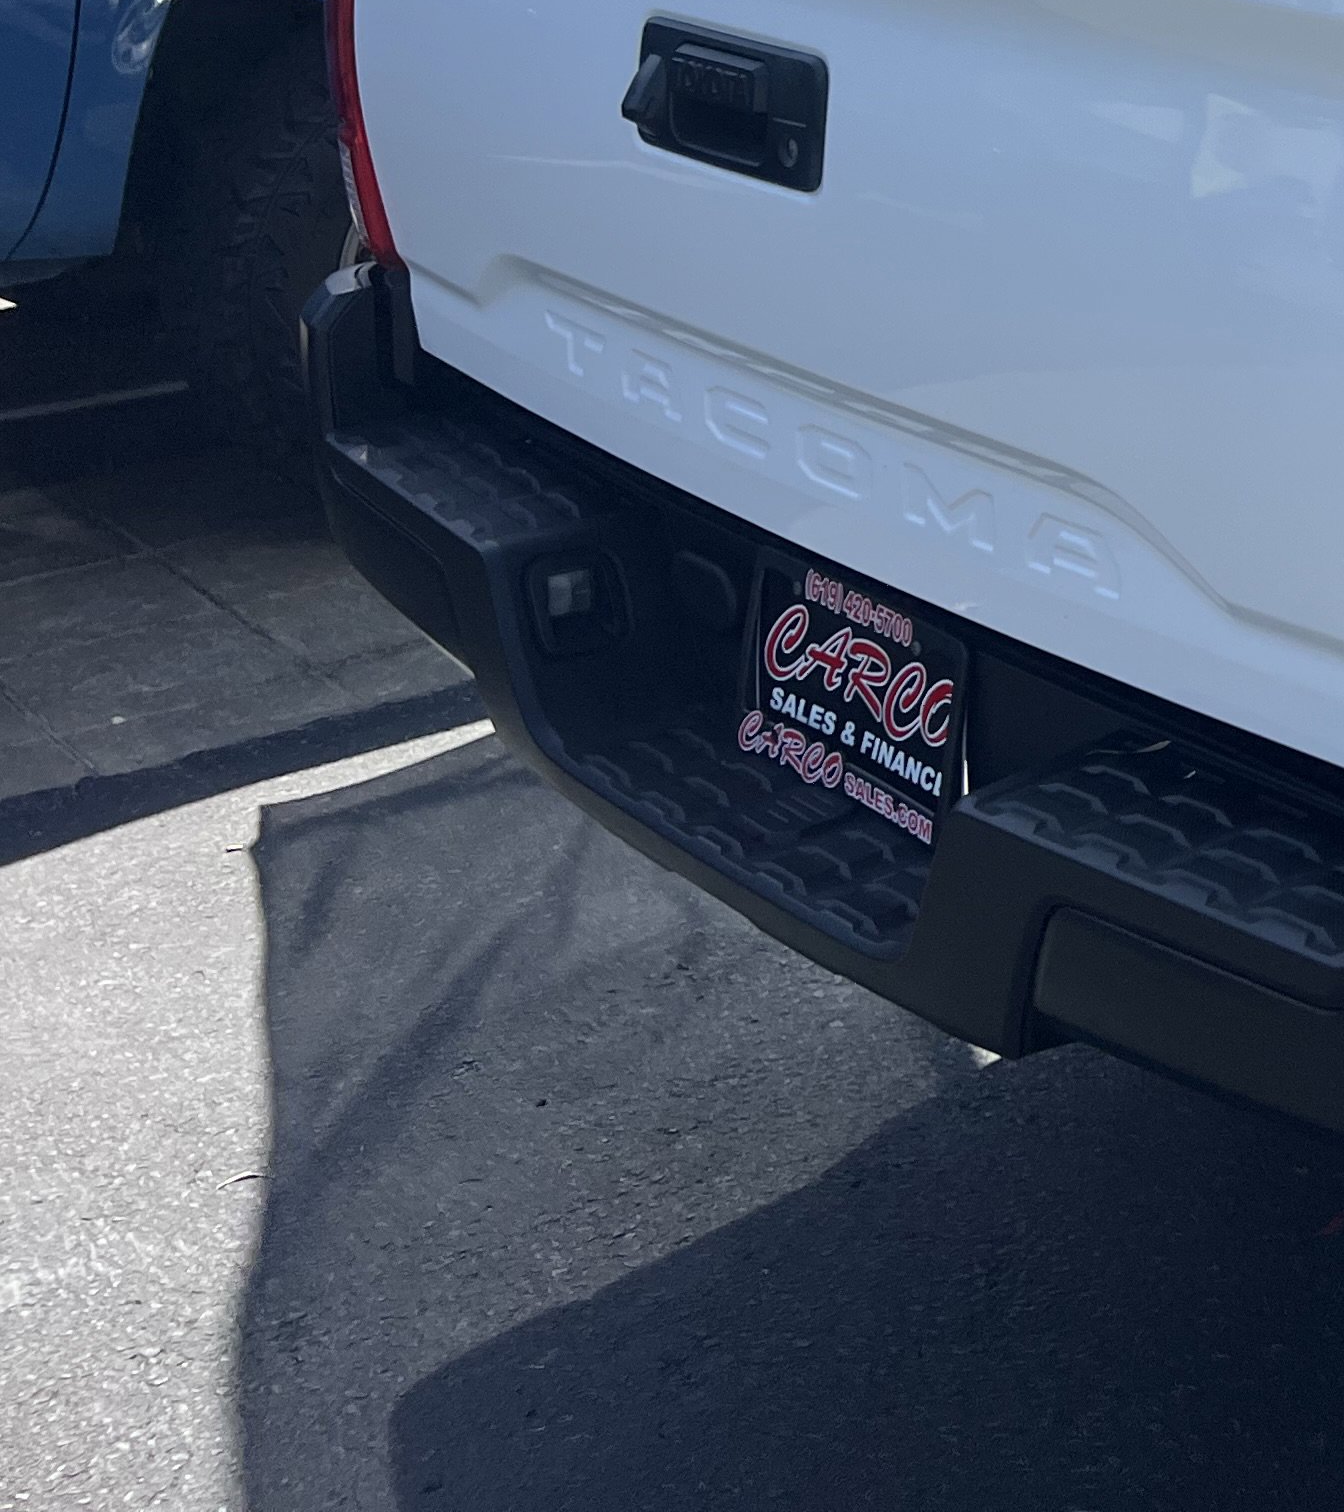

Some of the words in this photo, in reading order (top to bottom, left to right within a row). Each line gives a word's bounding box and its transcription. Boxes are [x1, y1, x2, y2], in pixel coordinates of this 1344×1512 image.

[543, 309, 1122, 601] TACOMA
[804, 568, 844, 614] (619)
[843, 590, 913, 647] 420-5700
[764, 604, 954, 747] CARCO
[770, 687, 837, 735] SALES
[840, 720, 856, 747] &
[738, 710, 844, 788] CARCO
[844, 772, 933, 845] SALES.COM
